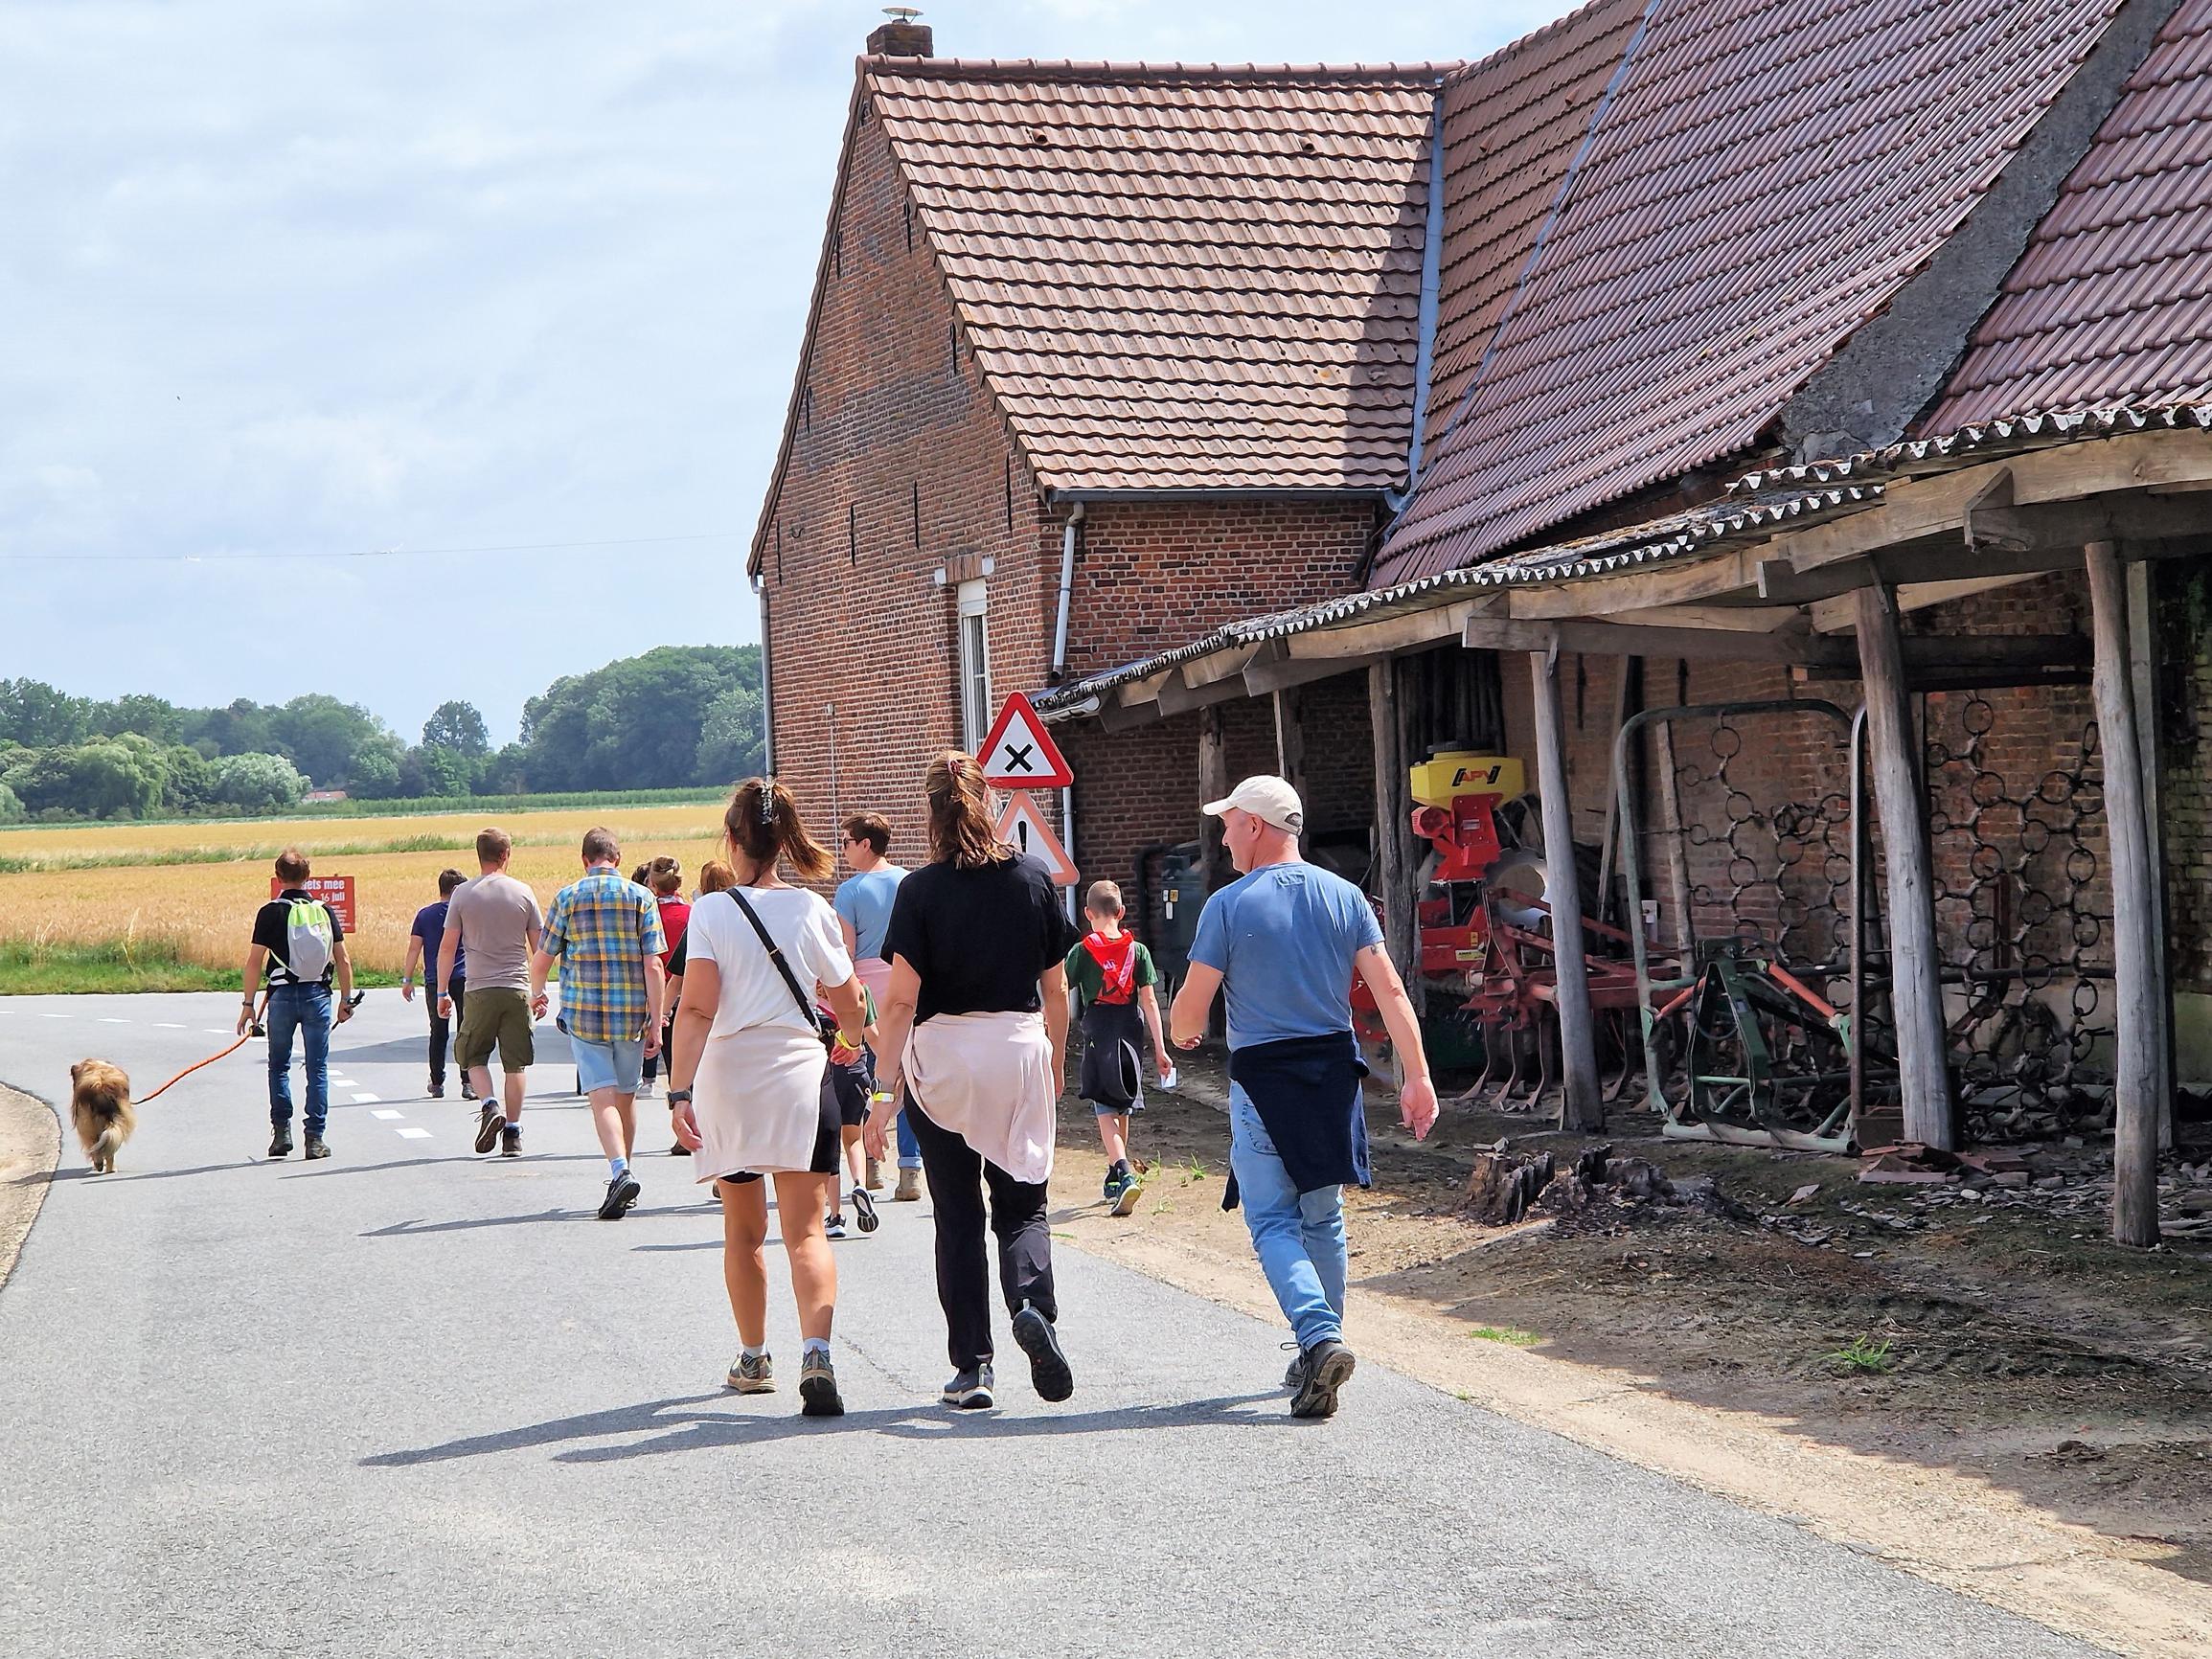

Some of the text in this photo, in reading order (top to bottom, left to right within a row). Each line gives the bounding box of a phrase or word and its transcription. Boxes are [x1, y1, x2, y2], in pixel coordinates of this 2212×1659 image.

[324, 880, 345, 890] mee
[320, 892, 345, 902] 16 juli
